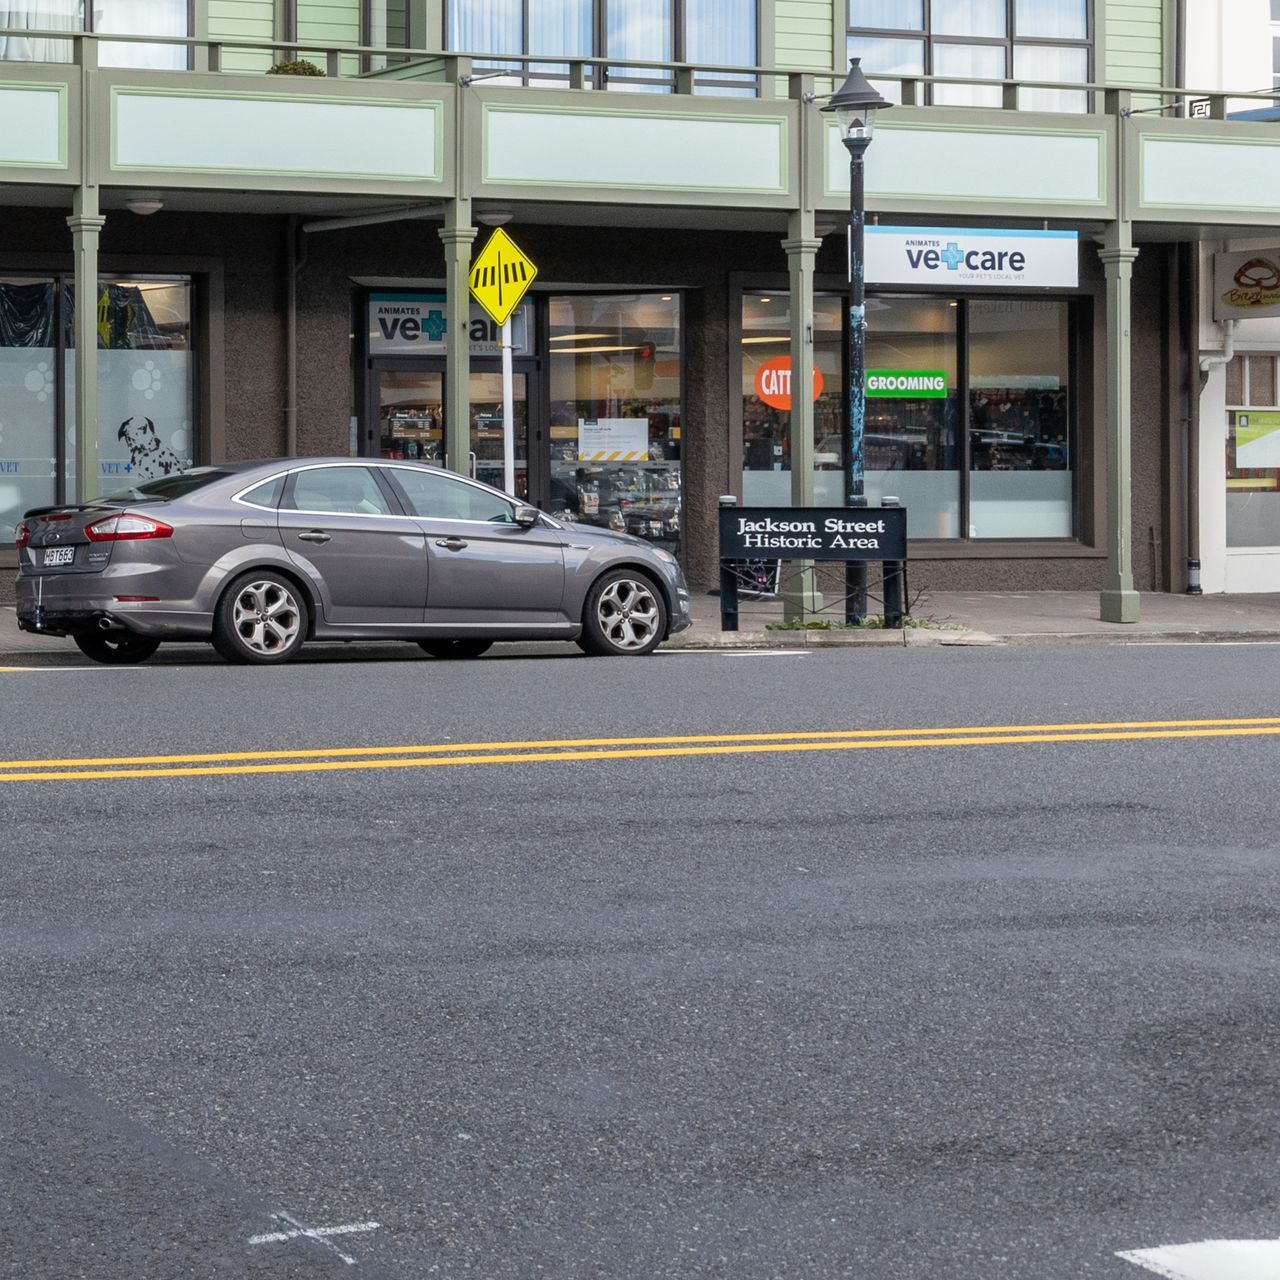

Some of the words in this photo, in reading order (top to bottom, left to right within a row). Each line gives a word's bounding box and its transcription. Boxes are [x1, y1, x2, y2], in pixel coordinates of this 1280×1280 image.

[905, 239, 940, 247] ANIMATES
[377, 307, 421, 315] ANIMATES
[867, 376, 945, 391] GROOMING
[0, 461, 20, 473] VET
[101, 462, 121, 474] VET
[737, 517, 816, 535] Jackson
[824, 518, 886, 533] Street
[743, 533, 822, 548] Historic
[829, 534, 880, 549] Area
[45, 548, 74, 562] HBT663
